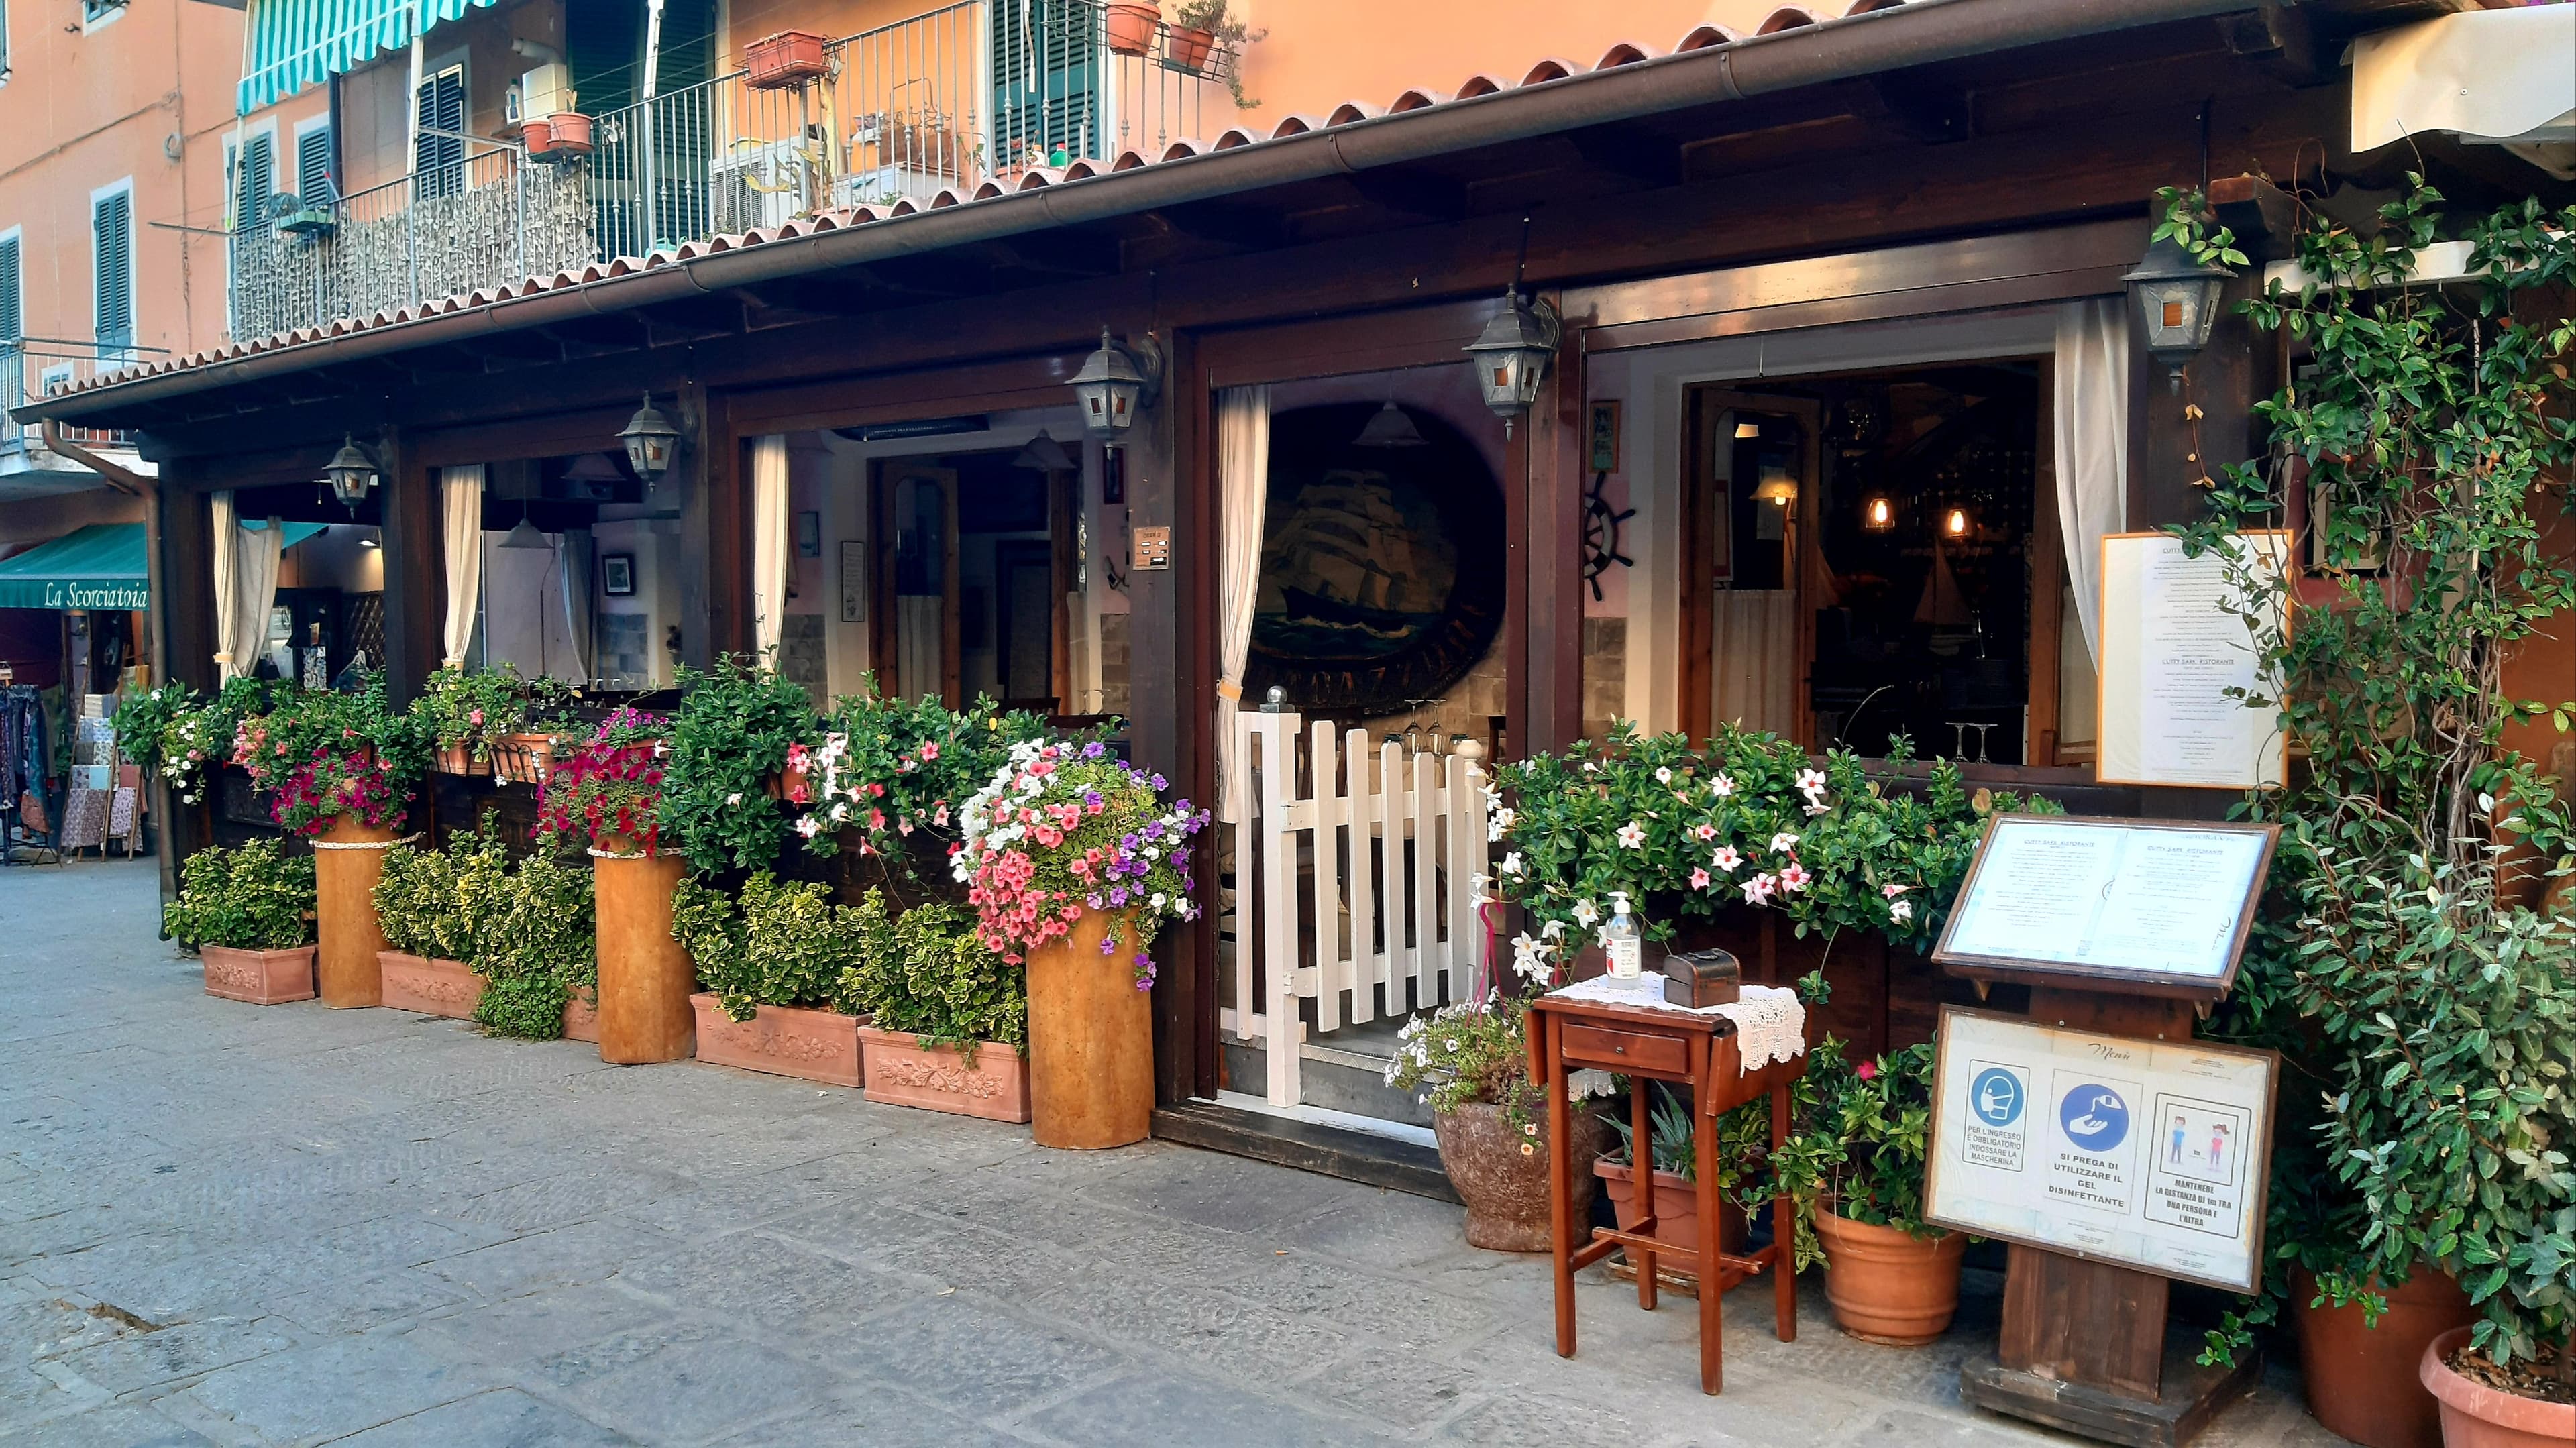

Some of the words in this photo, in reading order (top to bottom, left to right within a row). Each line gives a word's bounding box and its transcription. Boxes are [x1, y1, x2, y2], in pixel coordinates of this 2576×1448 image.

[44, 582, 62, 607] La
[67, 581, 148, 608] Scorciatoia
[1968, 1125, 1981, 1133] PER
[1973, 1135, 2021, 1150] OBBLIGATORIO
[1969, 1143, 2007, 1156] INDOSSARE
[2008, 1150, 2017, 1158] LA
[1971, 1152, 2014, 1166] MASCHERINA
[2060, 1153, 2070, 1161] SI
[2073, 1155, 2105, 1168] PREGA
[2054, 1163, 2111, 1180] UTILIZZARE
[2114, 1175, 2123, 1183] IL
[2077, 1180, 2096, 1190] GEL
[2049, 1185, 2125, 1207] DISINFETTANTE
[2155, 1186, 2163, 1194] LA
[2164, 1188, 2196, 1202] DISTANZA
[2198, 1195, 2205, 1203] DI
[2218, 1200, 2232, 1209] TRA
[2166, 1199, 2180, 1210] UNA
[2182, 1203, 2212, 1217] PERSONA
[2213, 1210, 2218, 1218] E
[2179, 1214, 2204, 1227] L'ALTRA
